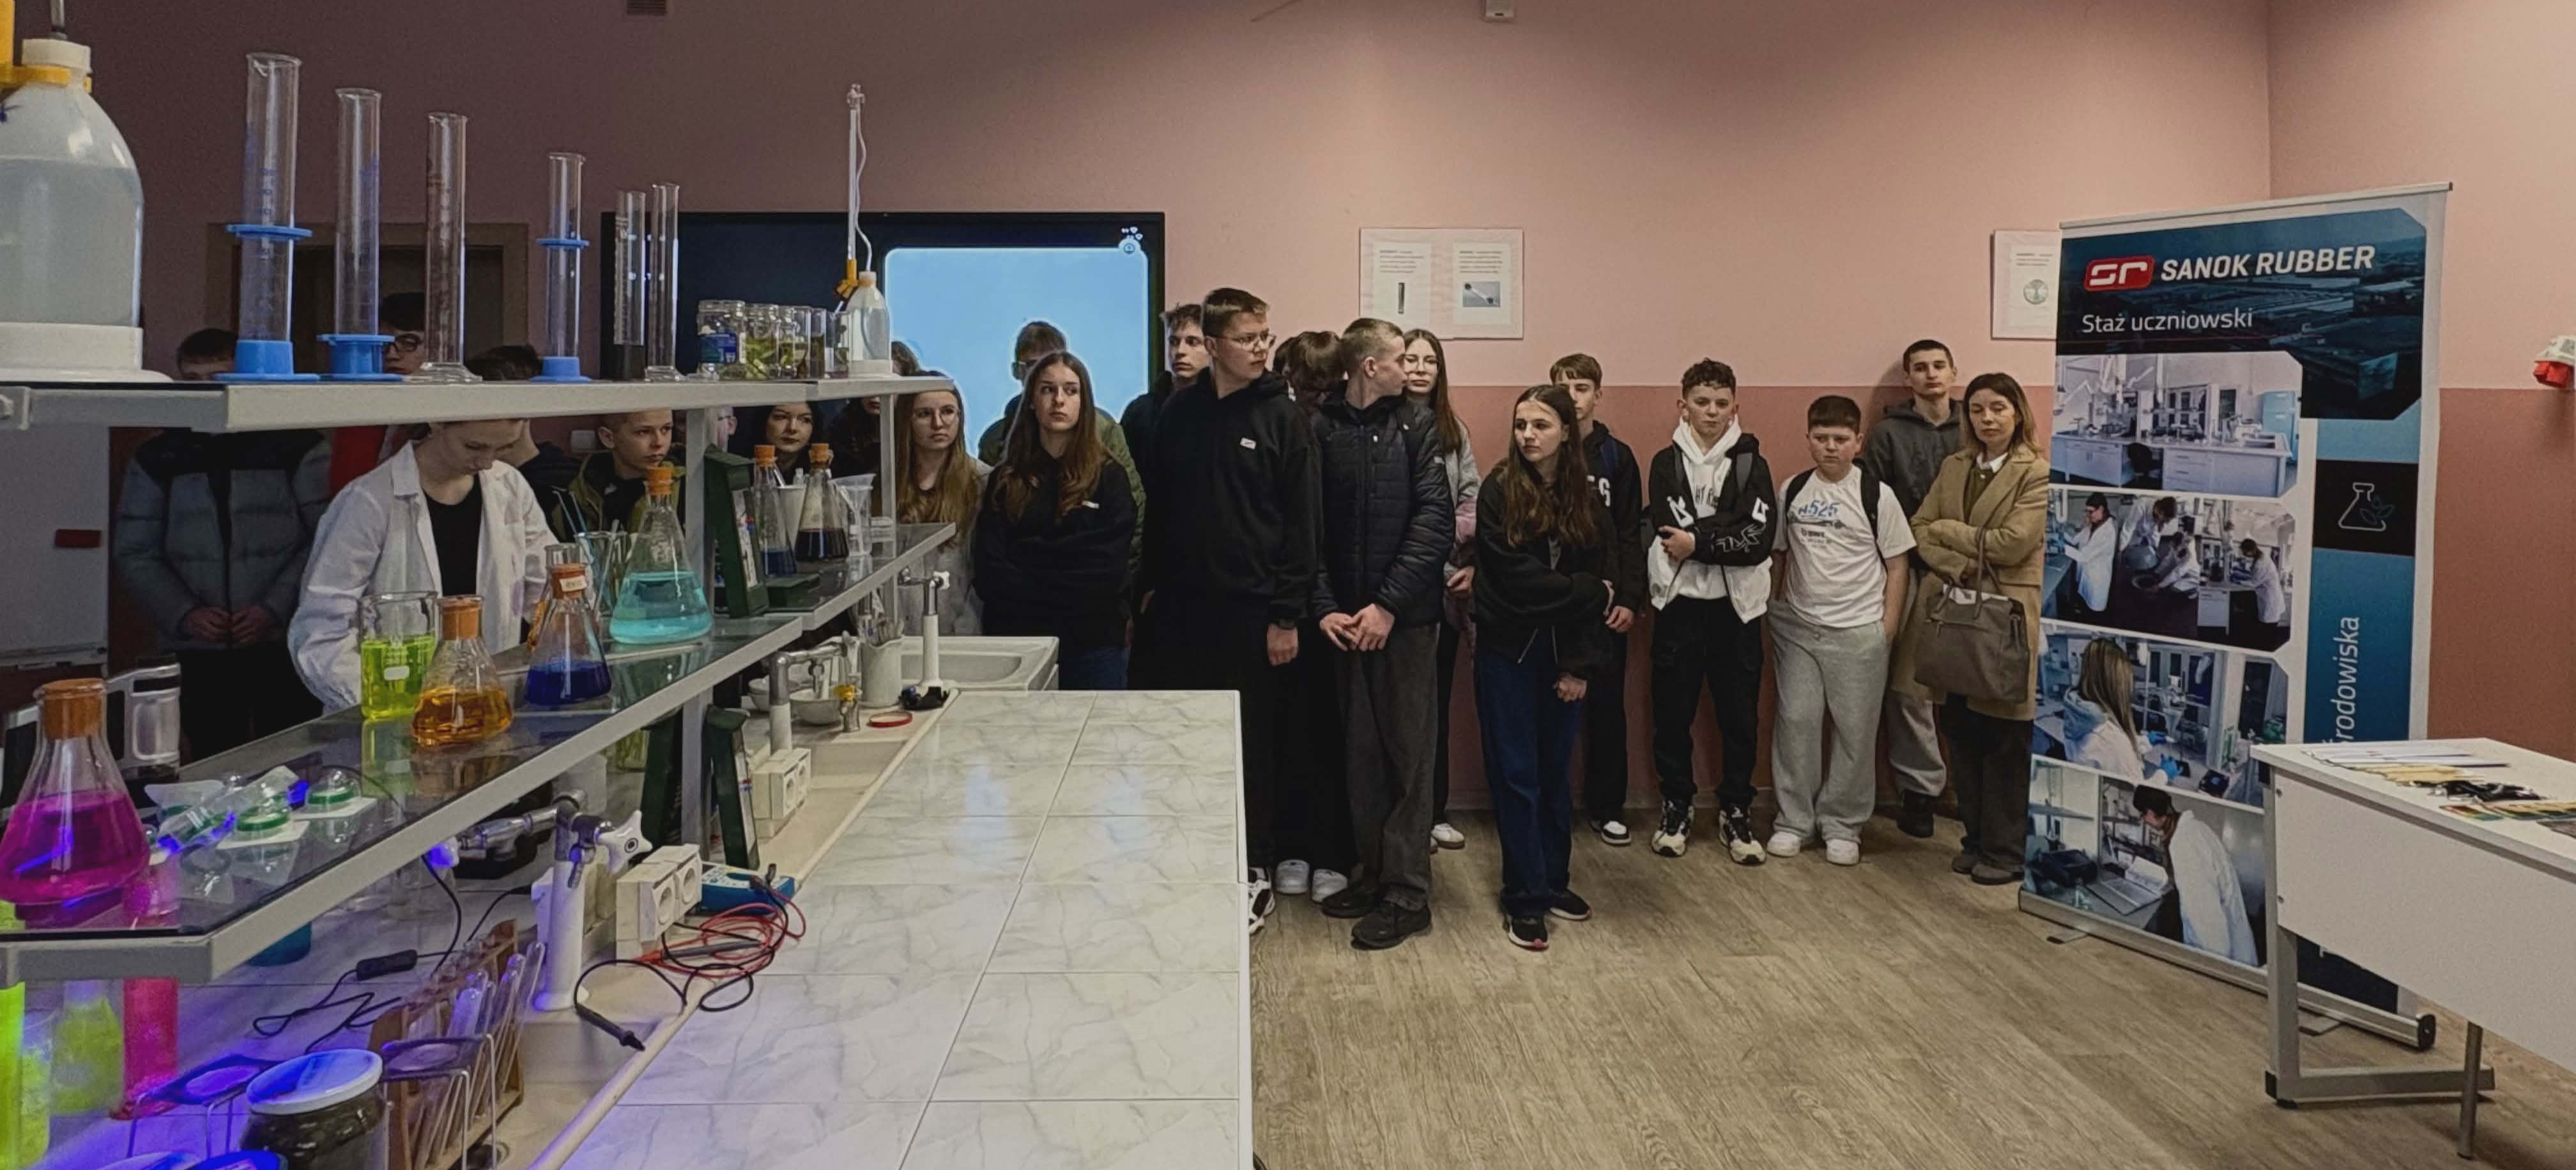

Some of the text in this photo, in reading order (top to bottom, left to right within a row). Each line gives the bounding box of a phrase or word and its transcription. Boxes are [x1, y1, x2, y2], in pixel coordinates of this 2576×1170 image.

[2161, 254, 2251, 281] SANOK
[2255, 245, 2375, 275] RUBBER
[2082, 307, 2253, 333] Staż uczniowski
[2322, 616, 2360, 743] rodowiska
